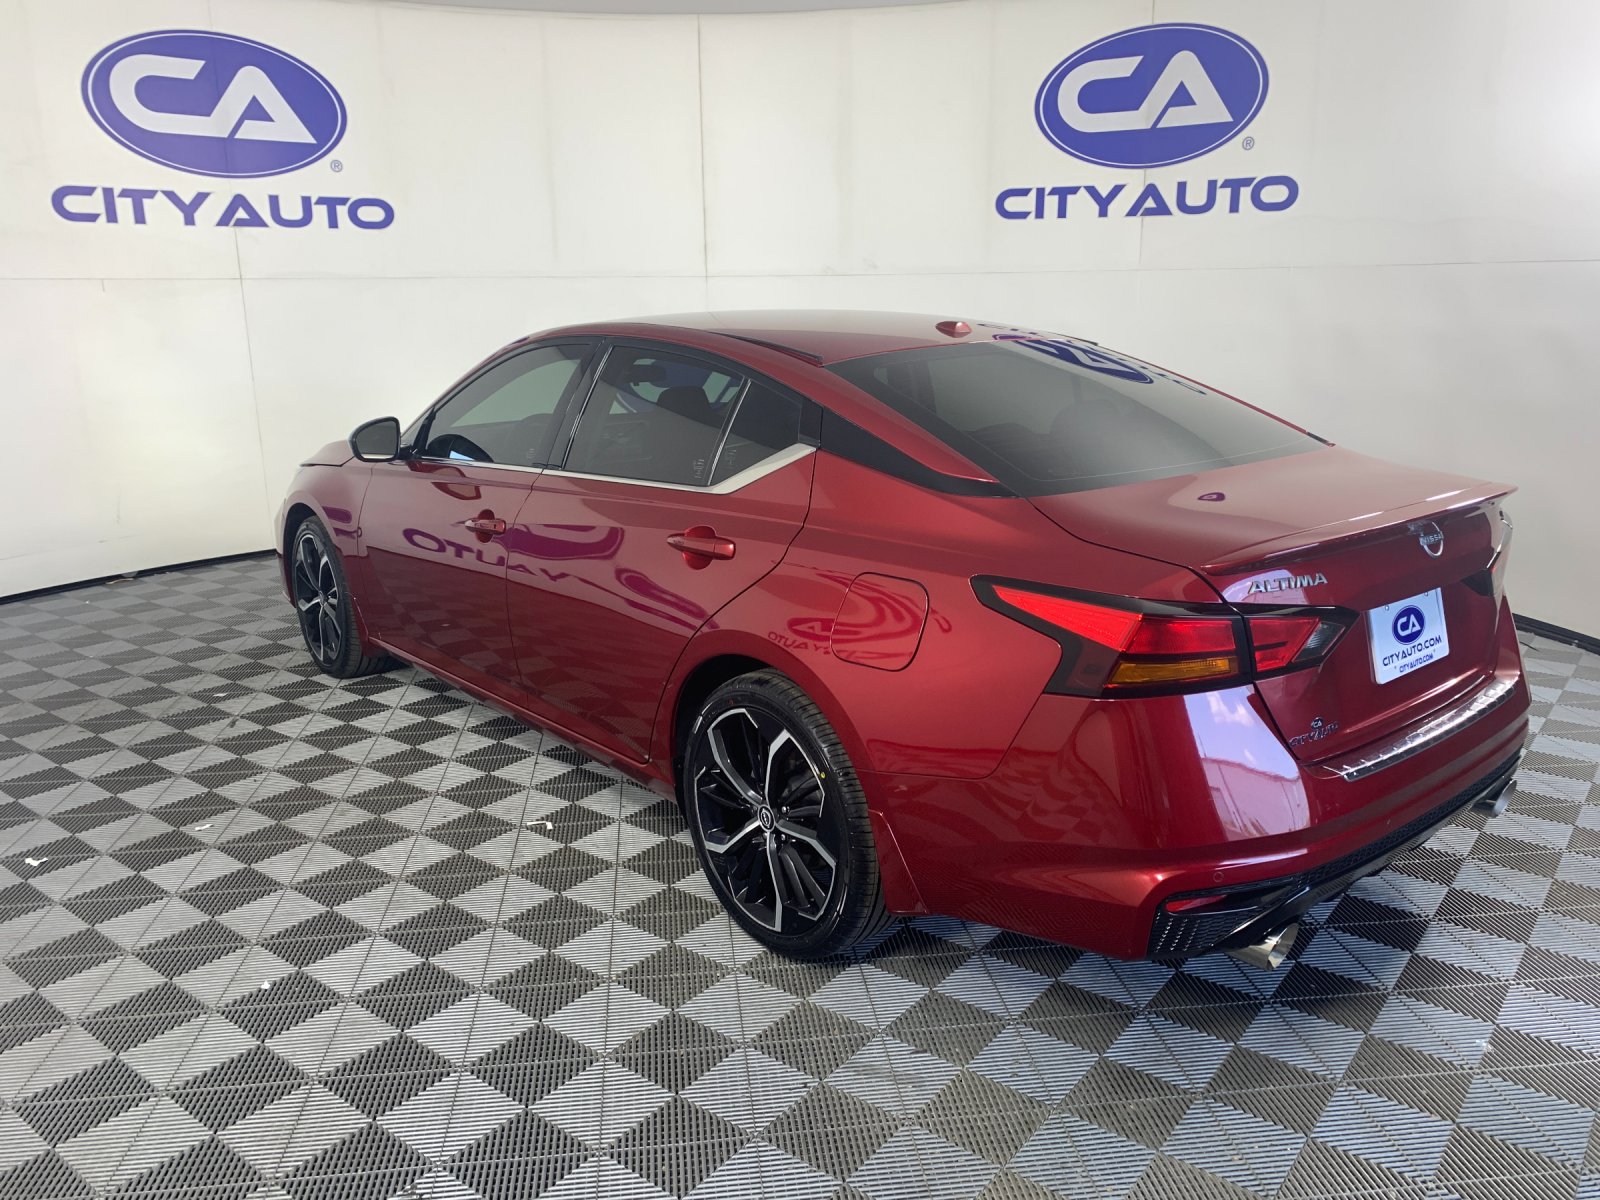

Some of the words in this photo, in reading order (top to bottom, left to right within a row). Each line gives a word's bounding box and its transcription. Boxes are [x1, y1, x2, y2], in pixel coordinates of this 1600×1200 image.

[109, 54, 318, 143] CA
[1057, 50, 1234, 133] CA
[1248, 573, 1328, 594] ALTIMA
[1397, 614, 1421, 637] CA
